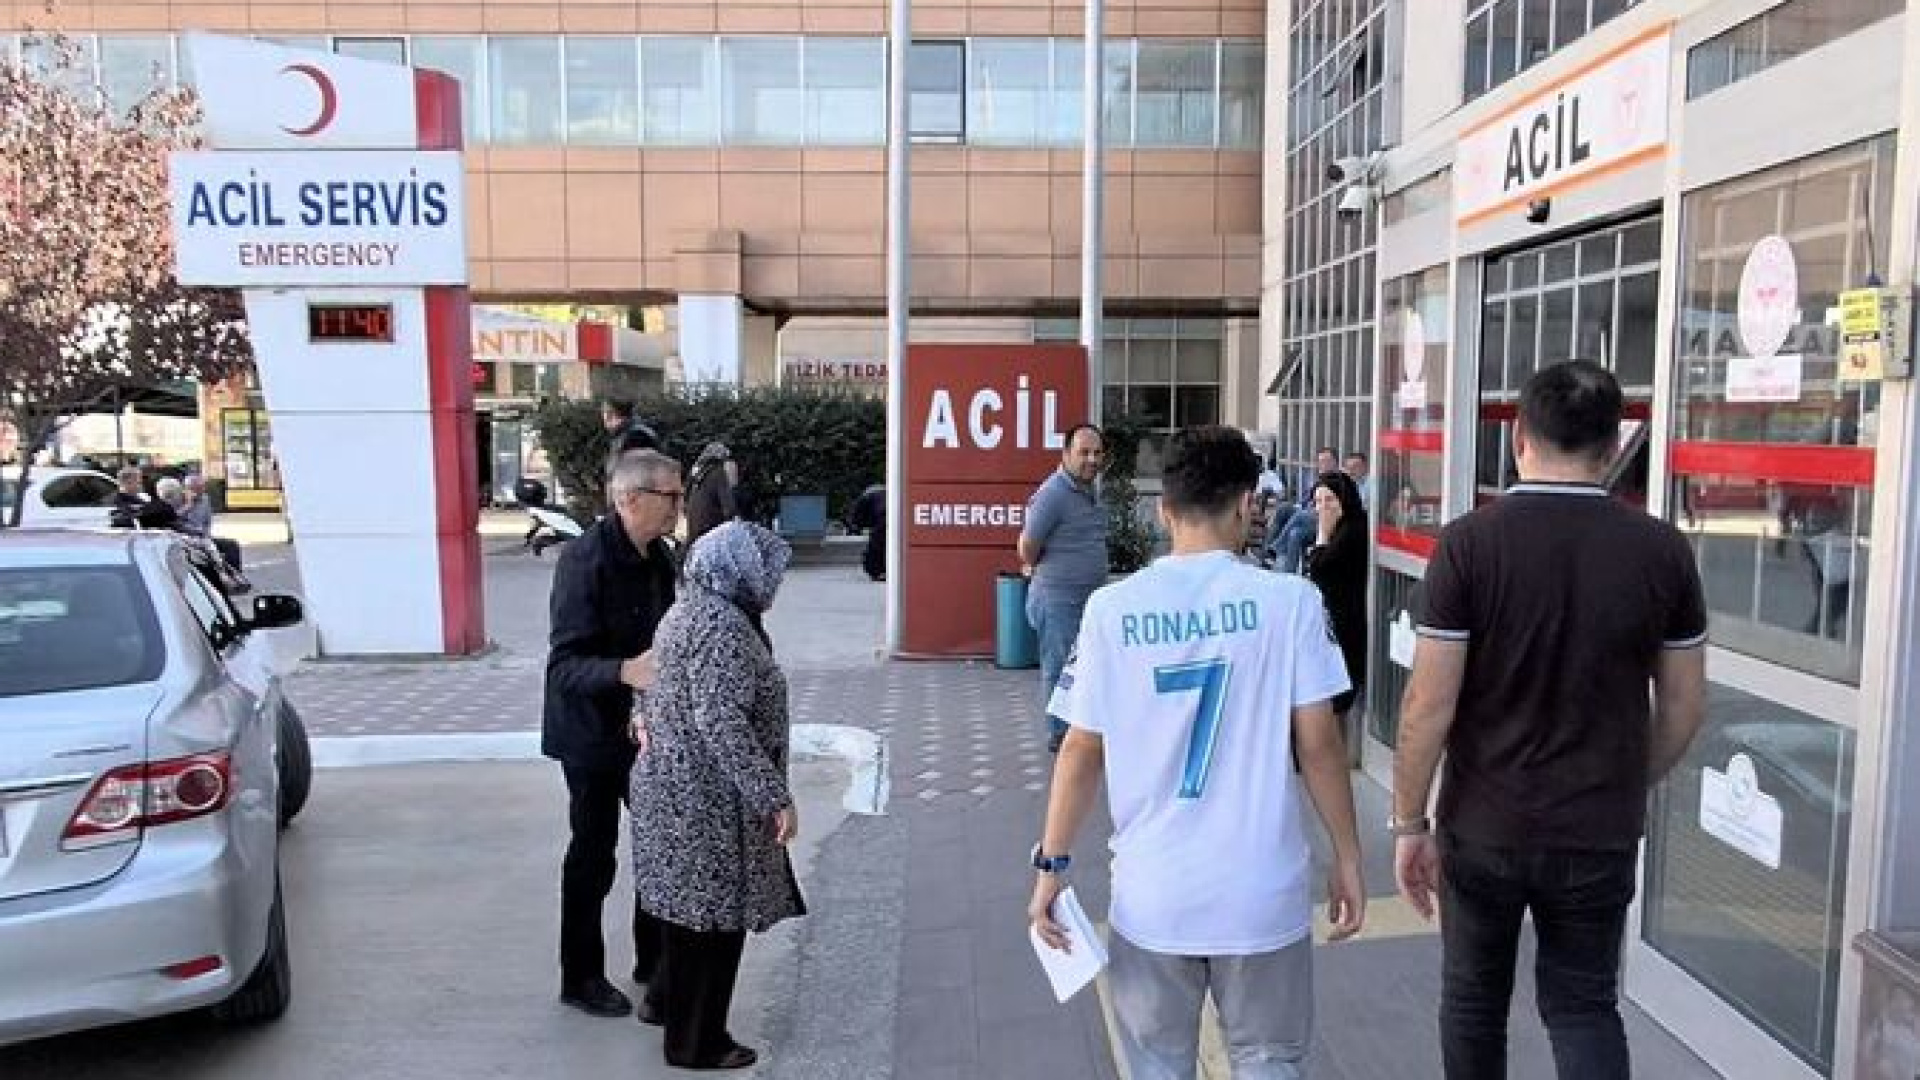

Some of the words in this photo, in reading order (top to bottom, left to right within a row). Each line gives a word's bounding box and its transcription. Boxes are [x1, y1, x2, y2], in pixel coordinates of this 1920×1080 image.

[1503, 91, 1591, 191] ACİL
[187, 167, 286, 226] ACİL
[299, 167, 448, 226] SERVİS
[238, 242, 399, 266] EMERGENCY
[472, 329, 568, 355] NTIN
[922, 373, 1066, 449] ACİL
[913, 503, 1029, 525] EMERGE
[1122, 600, 1259, 646] RONALDO
[1153, 655, 1233, 800] 7
